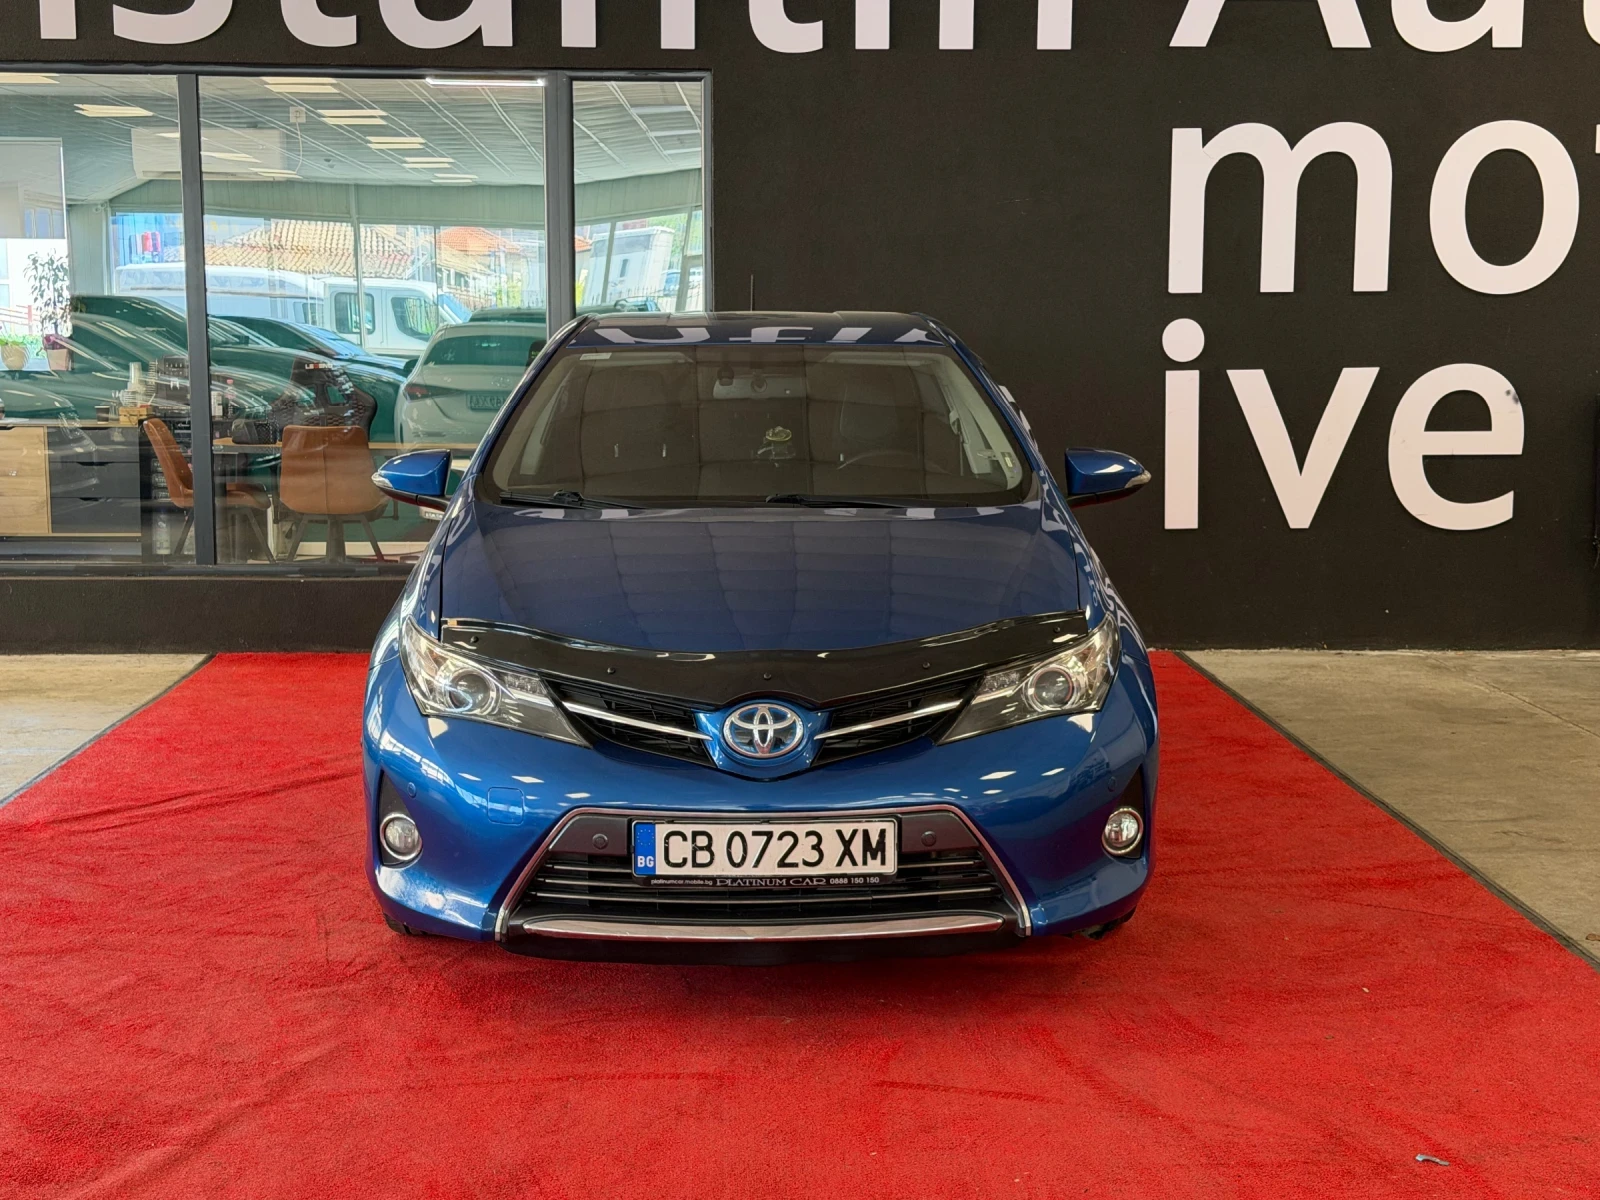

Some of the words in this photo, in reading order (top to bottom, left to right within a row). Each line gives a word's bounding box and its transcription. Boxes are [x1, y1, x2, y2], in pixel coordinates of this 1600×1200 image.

[1167, 119, 1600, 295] mo
[1161, 317, 1525, 531] ive
[637, 855, 655, 868] BG
[663, 829, 715, 869] CB
[725, 829, 825, 869] 0723
[834, 827, 887, 868] XM
[650, 877, 714, 887] platinumcar.mobile.bg
[715, 877, 787, 888] PLATINUM
[789, 876, 827, 887] CAR
[829, 876, 849, 885] 0888
[850, 876, 864, 885] 150
[866, 875, 880, 884] 150
